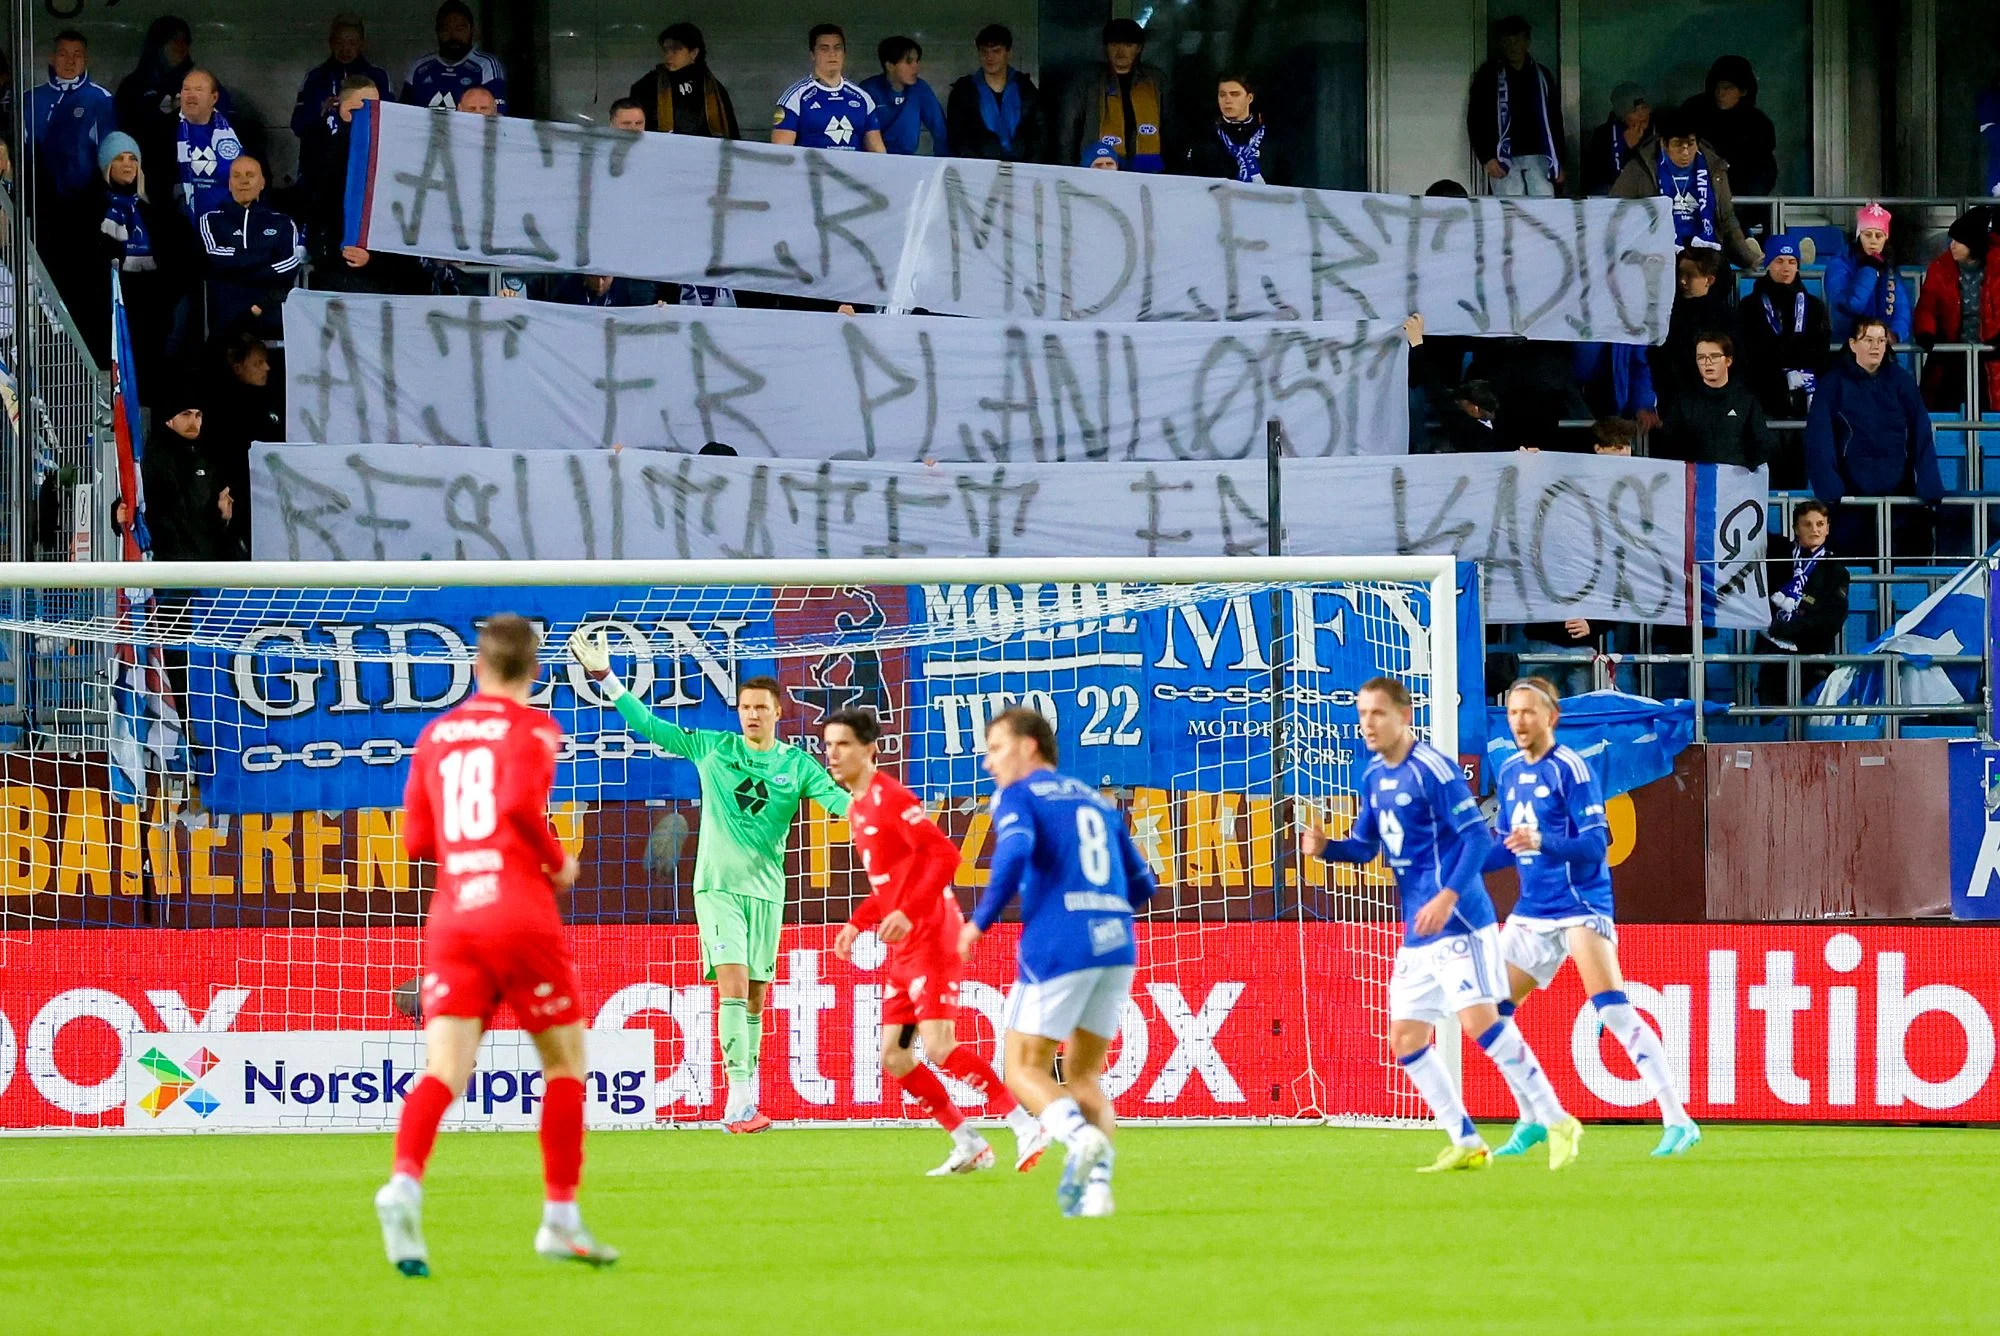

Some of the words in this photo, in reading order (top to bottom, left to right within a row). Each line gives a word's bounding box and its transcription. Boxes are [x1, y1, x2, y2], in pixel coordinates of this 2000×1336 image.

[393, 107, 644, 268] ALT
[704, 138, 889, 291] ER
[943, 160, 1668, 336] MIDLERTIDIG
[297, 299, 529, 446] ALT
[594, 317, 780, 457] ER
[264, 453, 1040, 561] RESULTATET
[1391, 465, 1672, 618] KAOS
[921, 583, 1139, 643] MOLDE
[1153, 588, 1464, 676] MFY
[233, 618, 754, 717] GIDON
[933, 689, 1058, 756] TIFO
[1077, 685, 1142, 746] 22
[1268, 746, 1354, 766] NGRE
[438, 747, 498, 844] 18
[1075, 805, 1111, 887] 8
[592, 930, 1247, 1109] atibx
[1571, 932, 1997, 1110] altib
[244, 1059, 409, 1105] Norsk
[427, 1059, 646, 1115] ippng
